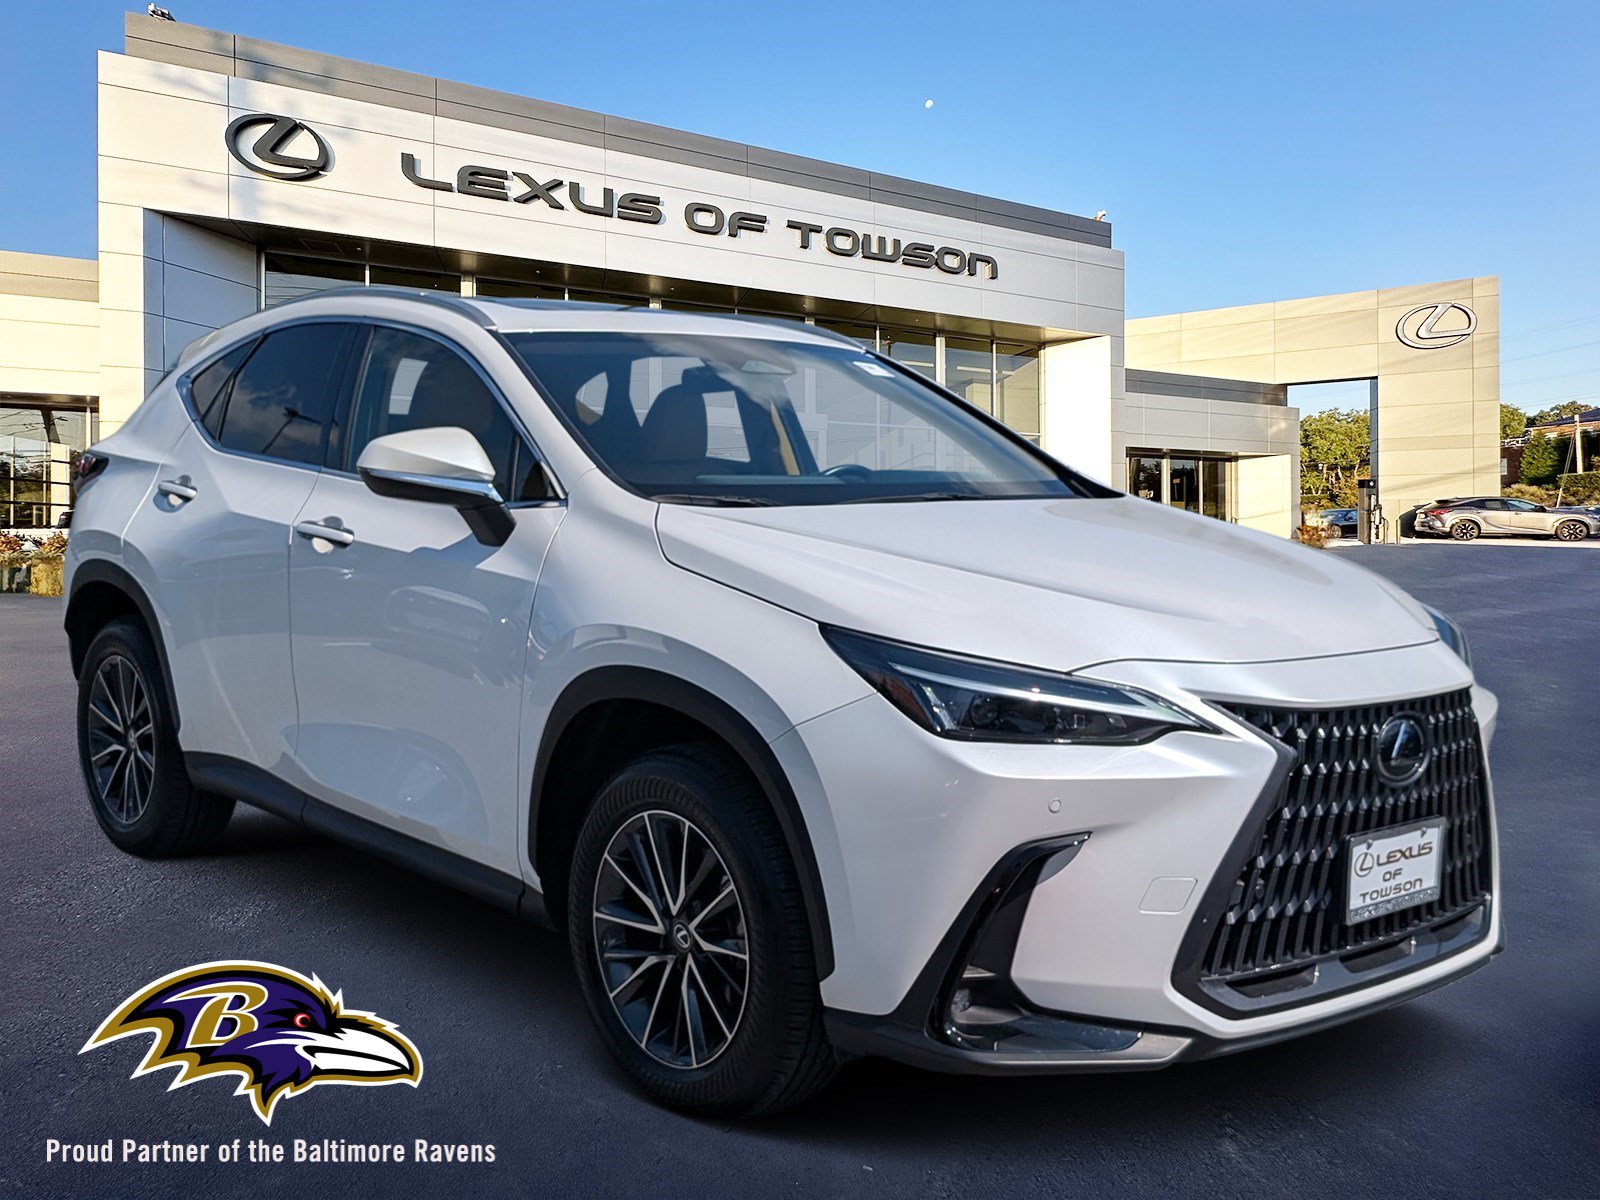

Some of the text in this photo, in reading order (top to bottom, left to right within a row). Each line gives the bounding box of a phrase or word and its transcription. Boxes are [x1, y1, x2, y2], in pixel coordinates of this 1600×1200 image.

[401, 152, 998, 280] LEXUS OF TOWSON
[1376, 841, 1433, 867] LEXUS
[1382, 867, 1403, 882] OF
[1359, 877, 1423, 903] TOWSON
